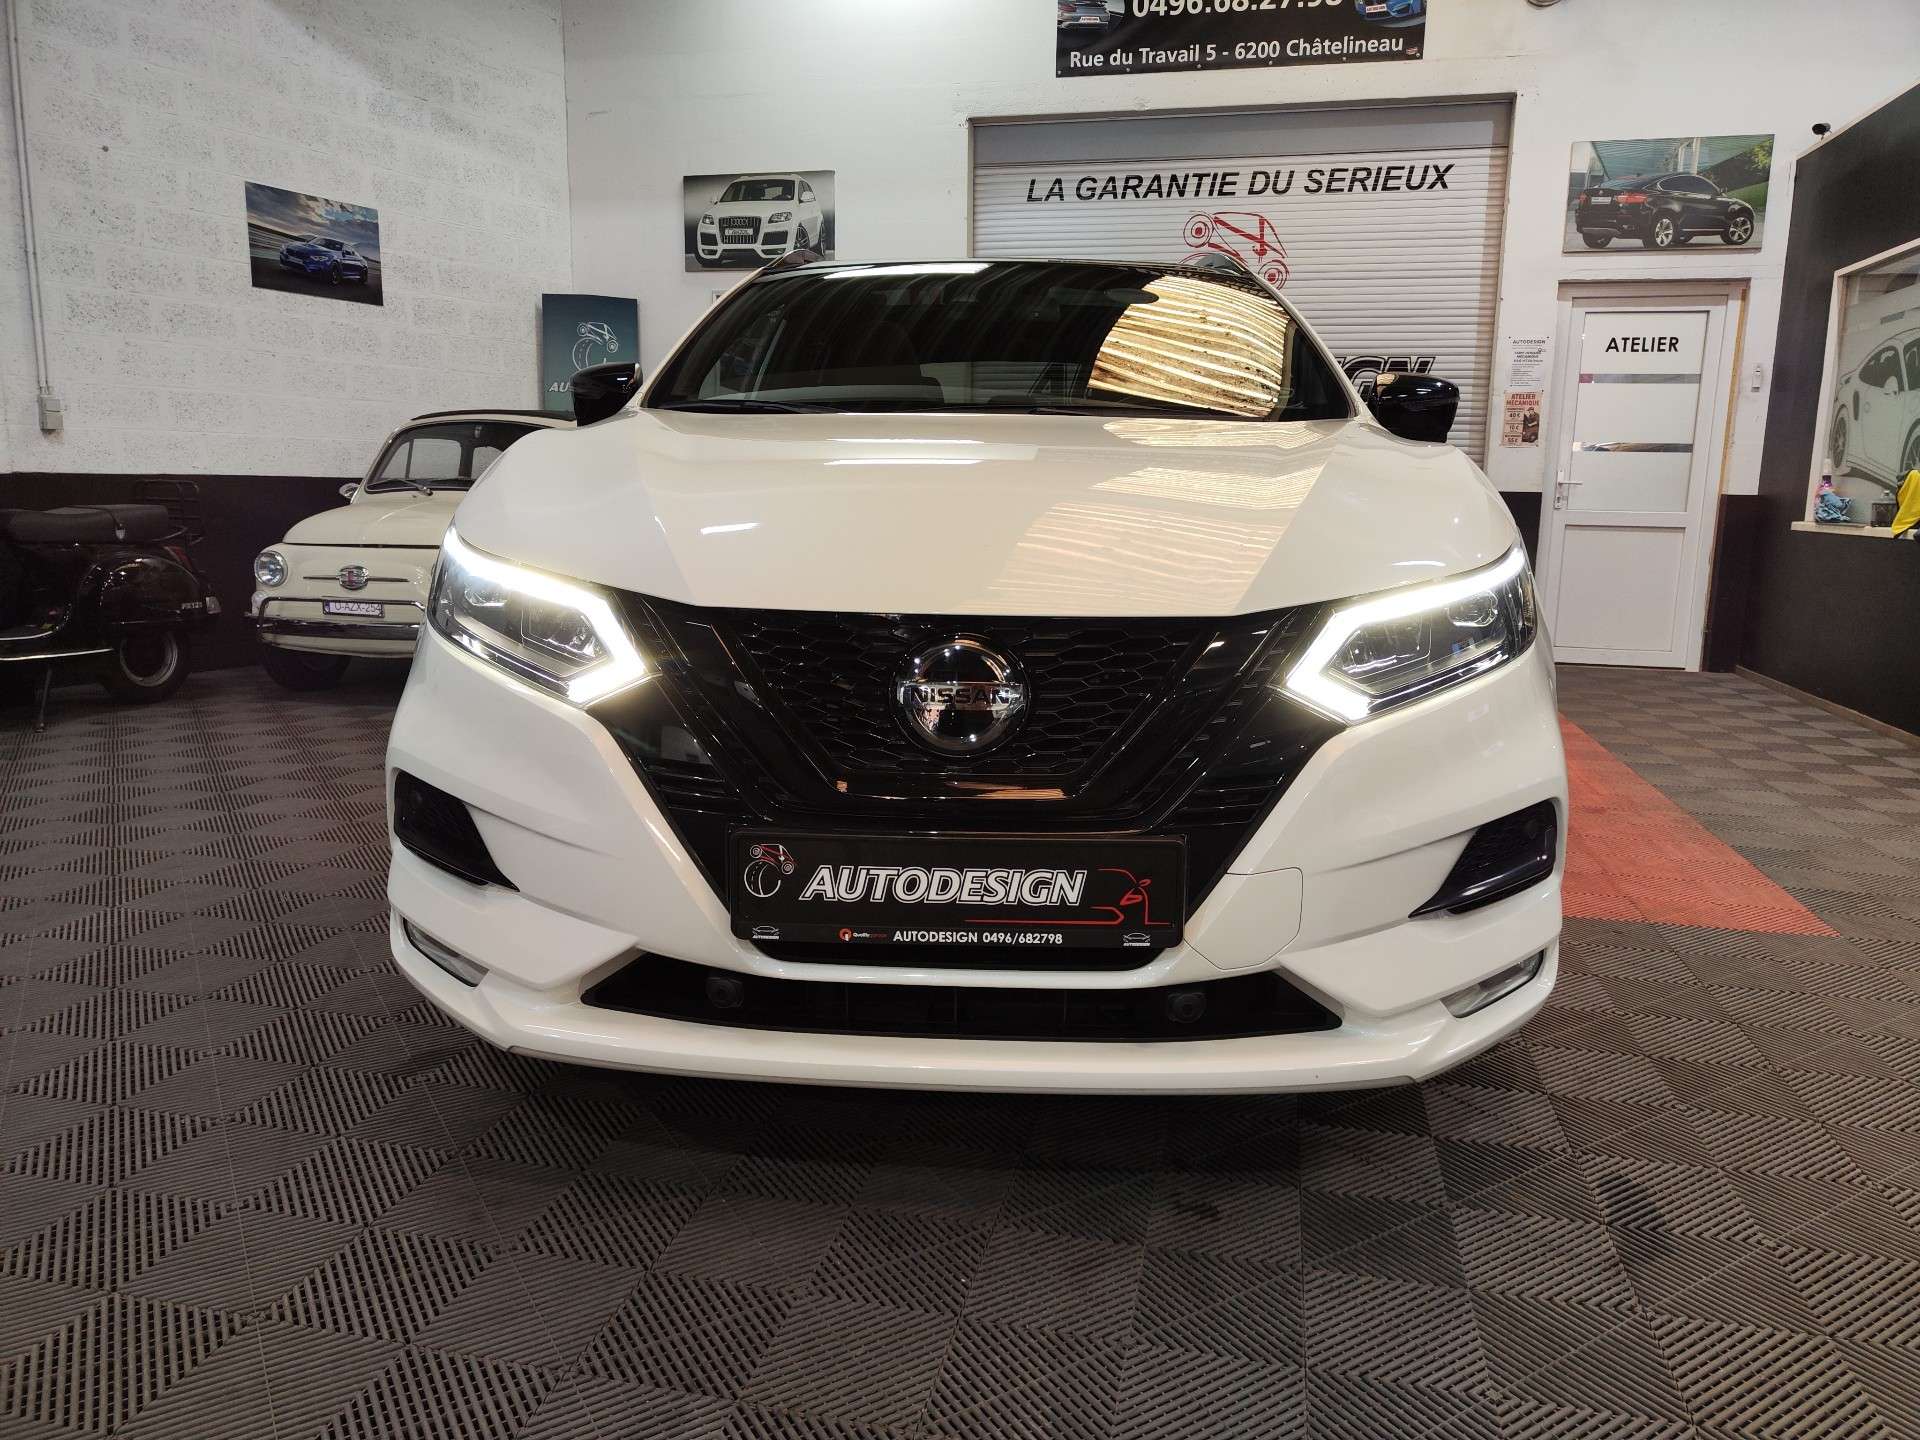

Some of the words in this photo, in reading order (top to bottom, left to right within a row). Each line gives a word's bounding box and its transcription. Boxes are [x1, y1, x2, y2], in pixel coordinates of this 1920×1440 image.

[1070, 51, 1104, 68] Rue
[1109, 48, 1133, 66] du
[1139, 44, 1200, 64] Travail
[1206, 44, 1217, 61] 5
[1234, 40, 1280, 60] 6200
[1286, 36, 1404, 57] Châtelineau
[1026, 177, 1065, 202] LA
[1075, 171, 1240, 201] GARANTIE
[1248, 169, 1295, 195] DU
[1304, 163, 1456, 194] SERIEUX
[1605, 336, 1680, 353] ATELIER
[911, 686, 1010, 703] NISSAN
[799, 865, 1087, 906] AUTODESIGN
[893, 931, 978, 943] AUTODESIGN
[982, 932, 1063, 945] 0496/682798
